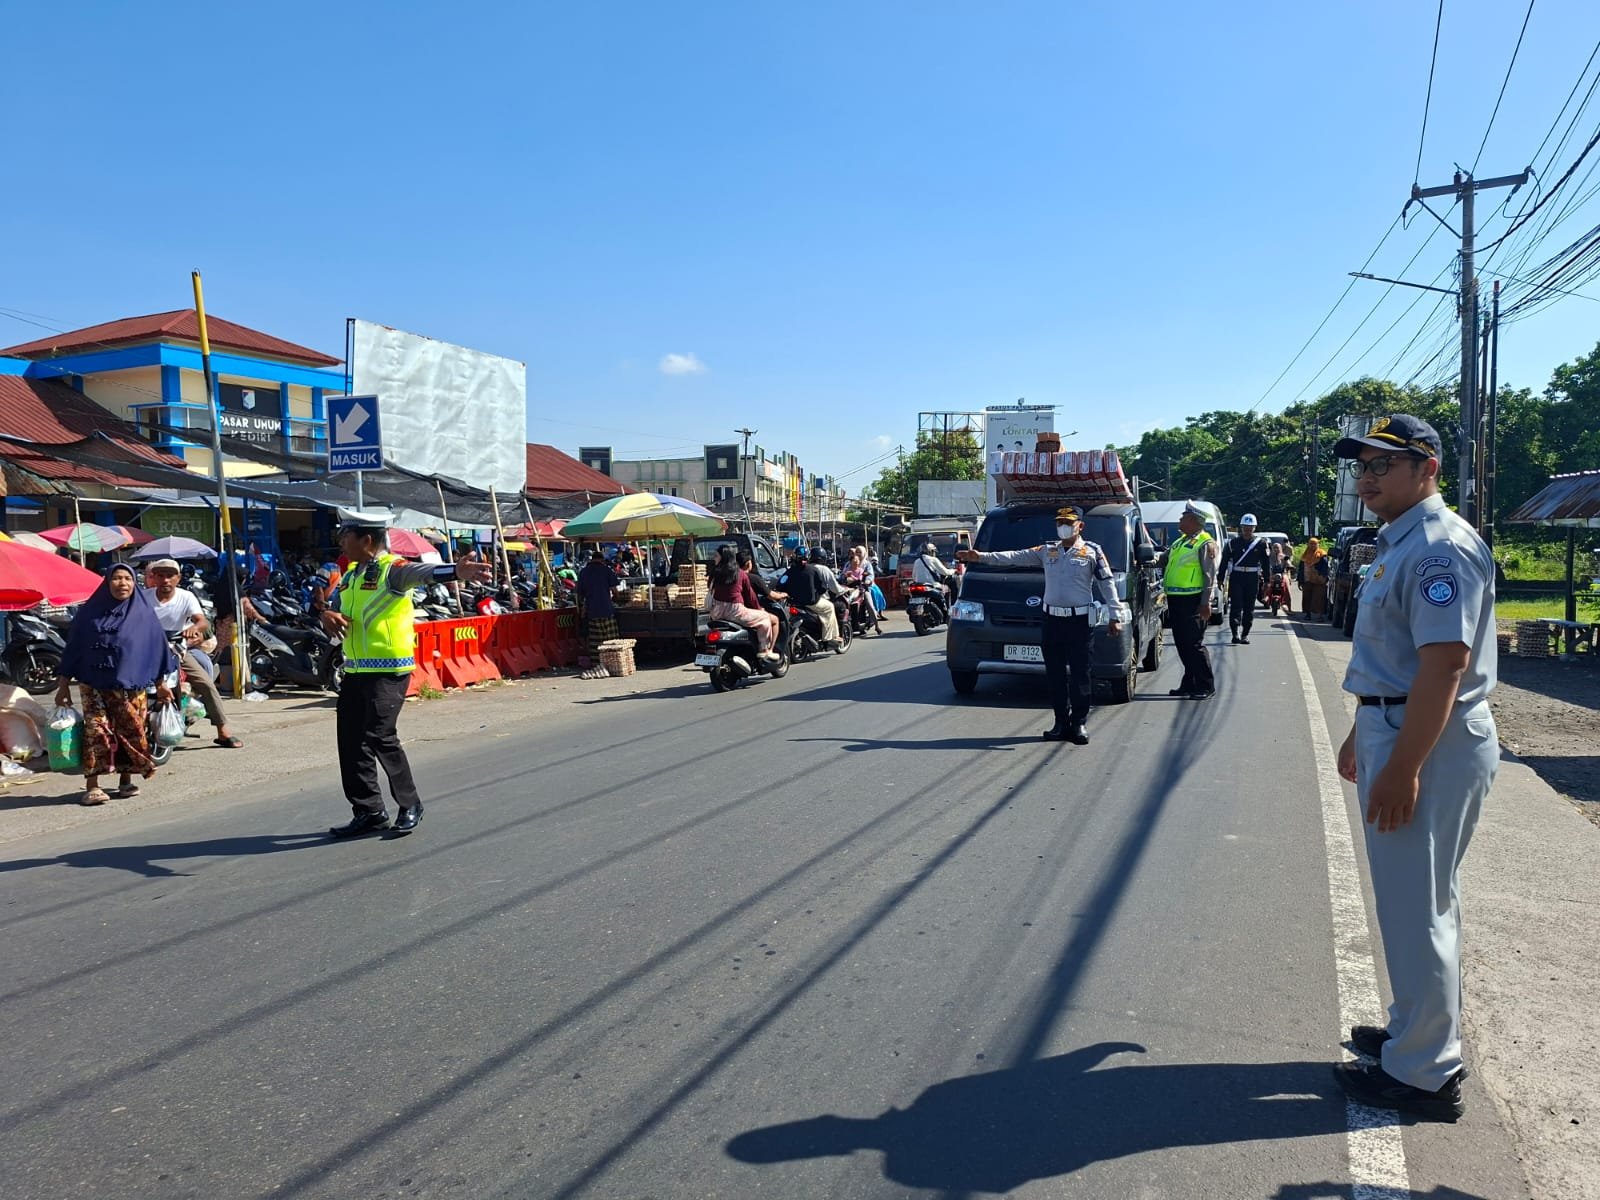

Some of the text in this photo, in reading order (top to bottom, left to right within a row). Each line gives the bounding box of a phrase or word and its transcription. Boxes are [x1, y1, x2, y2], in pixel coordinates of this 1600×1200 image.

[219, 415, 282, 431] PASAR UMUM
[231, 430, 271, 442] KEDIRI
[332, 452, 378, 466] MASUK
[159, 520, 202, 533] RATU
[1007, 646, 1040, 657] DR 8132
